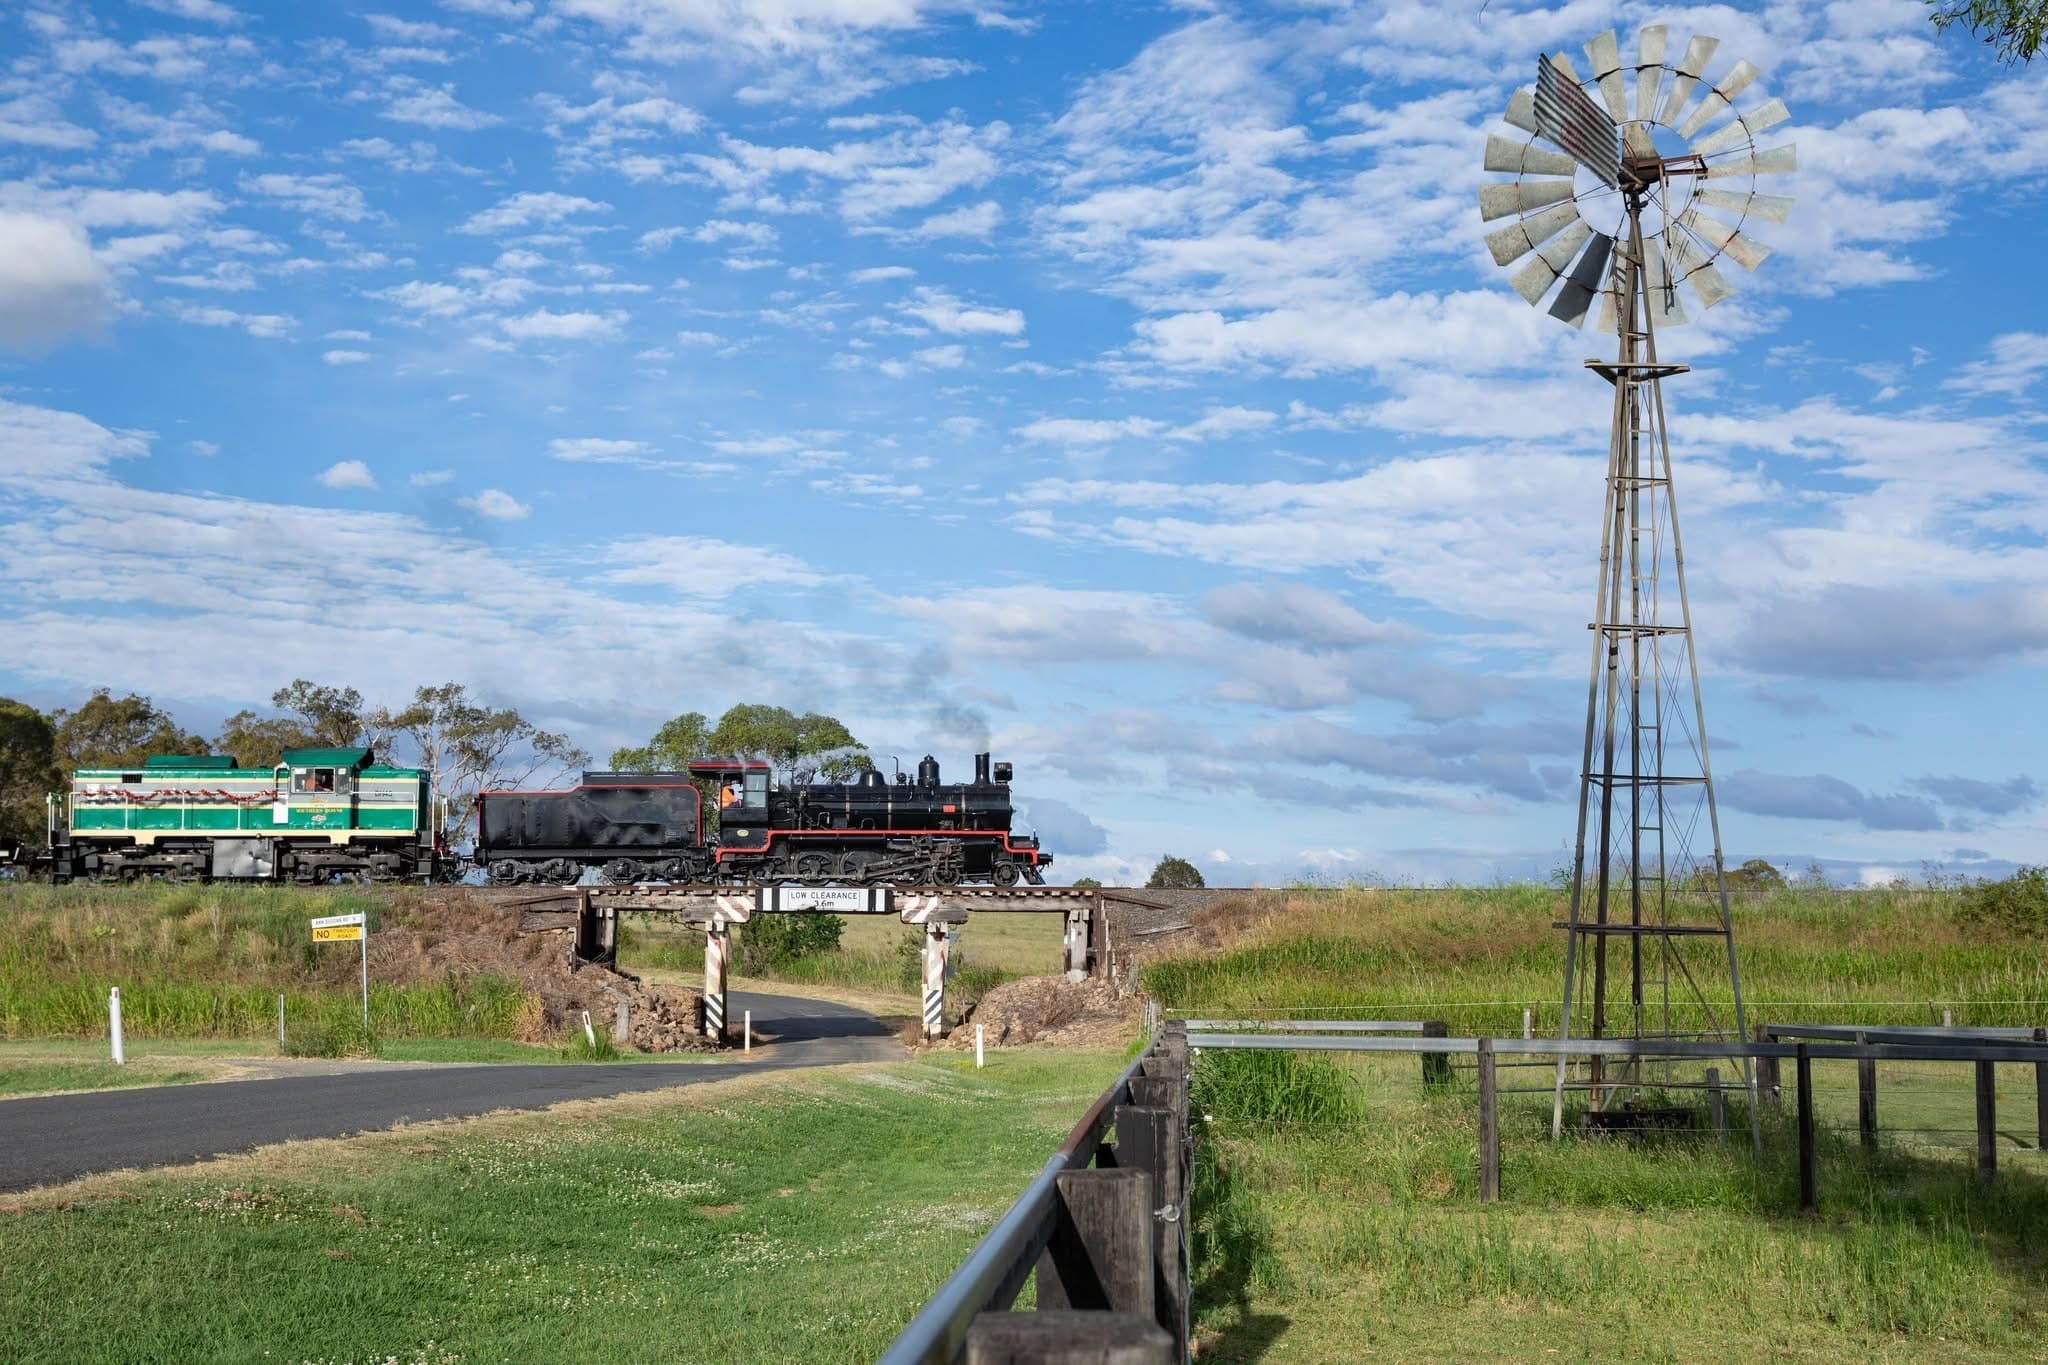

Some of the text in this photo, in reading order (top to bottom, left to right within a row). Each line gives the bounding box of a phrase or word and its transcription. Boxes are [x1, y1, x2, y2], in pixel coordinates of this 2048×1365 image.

[790, 891, 857, 899] LOW CLEARANCE
[316, 930, 330, 939] NO
